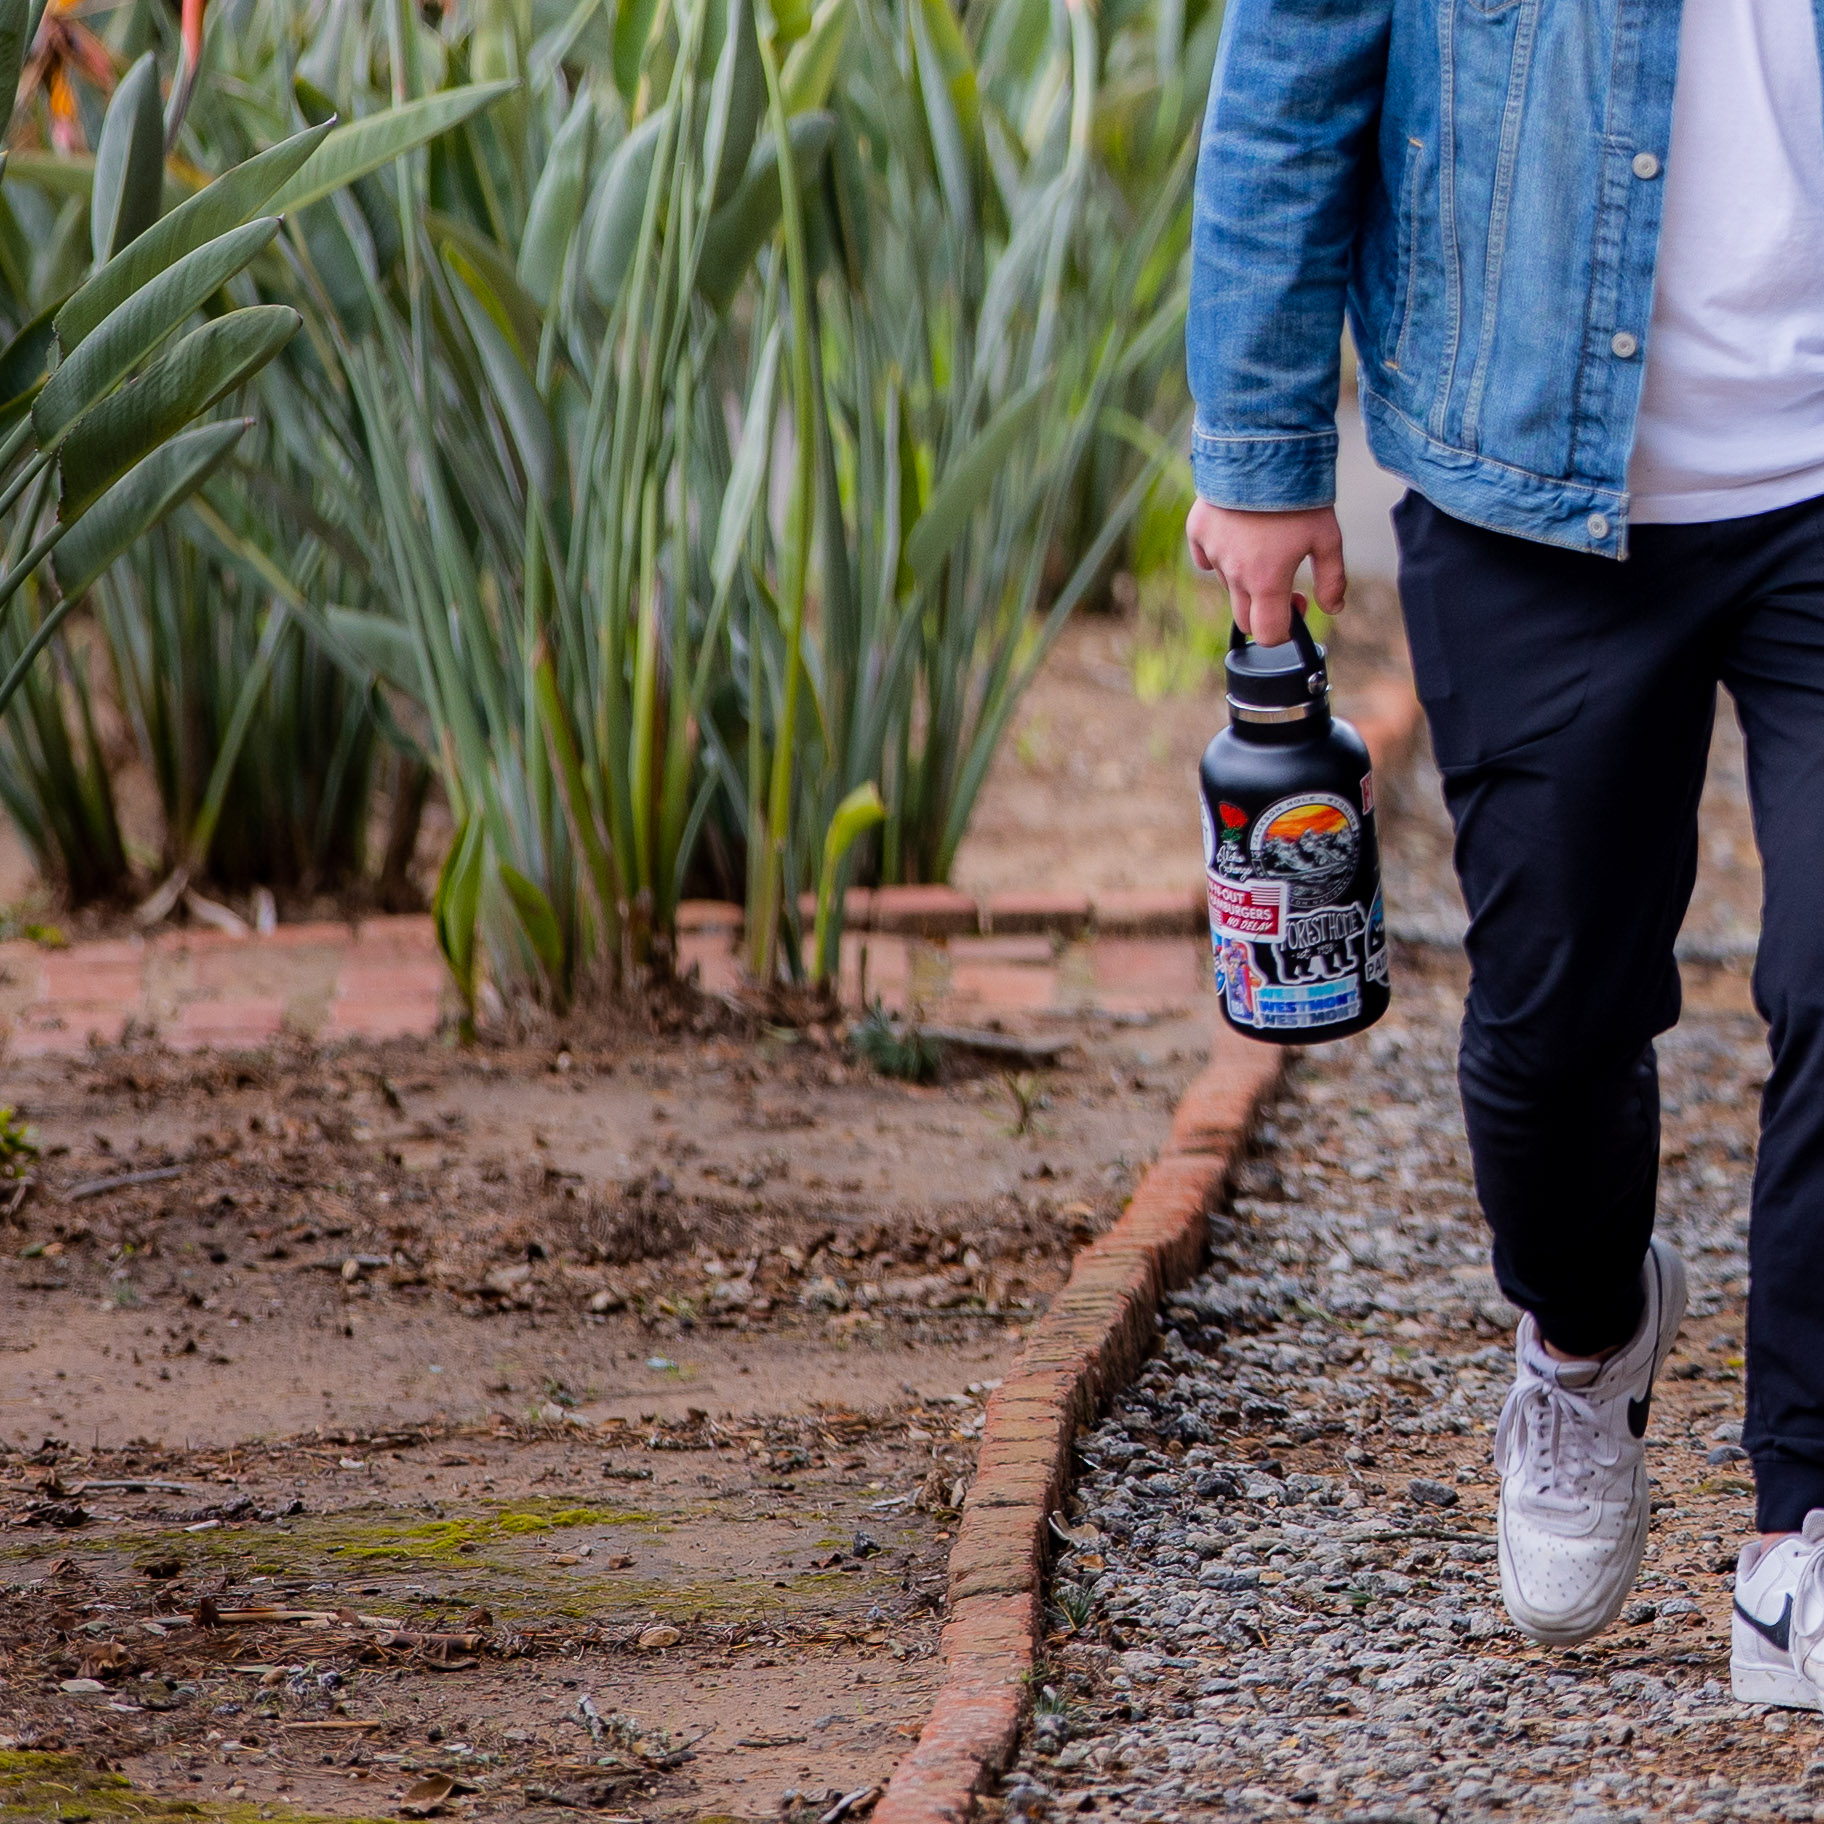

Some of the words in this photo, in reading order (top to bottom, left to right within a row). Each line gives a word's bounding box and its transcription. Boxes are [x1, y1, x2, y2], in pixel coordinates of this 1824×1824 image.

[1252, 805, 1283, 845] JACKSON
[1286, 795, 1316, 807] HOLE
[1327, 796, 1357, 827] WYOMING
[1226, 916, 1240, 928] NO
[1240, 918, 1274, 933] DELAY
[1328, 911, 1358, 941] HOME
[1259, 989, 1357, 1013] WESTMONT
